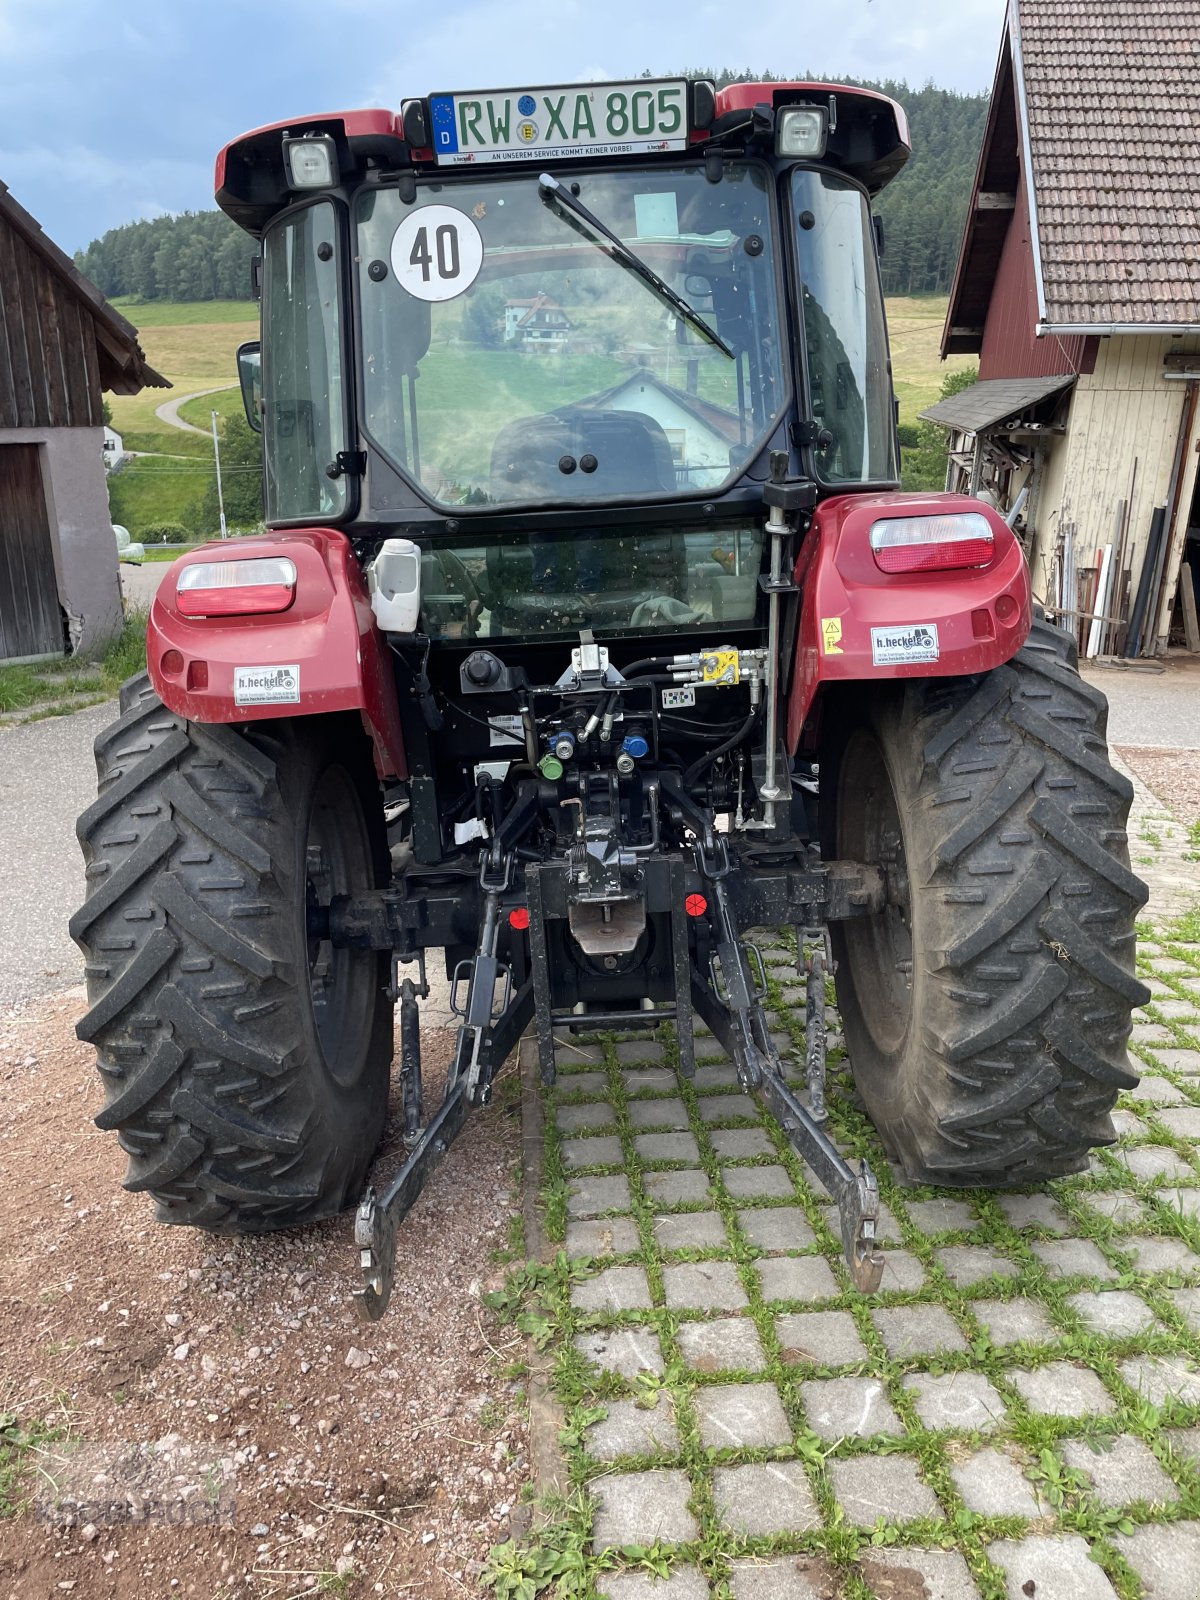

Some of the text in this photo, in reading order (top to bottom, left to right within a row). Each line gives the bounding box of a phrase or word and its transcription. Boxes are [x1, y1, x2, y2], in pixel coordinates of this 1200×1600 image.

[458, 89, 681, 146] RW XA 805
[441, 132, 450, 145] D
[503, 151, 533, 160] UNSEREM
[534, 149, 559, 158] SERVICE
[561, 148, 584, 156] KOMMT
[585, 146, 609, 155] KEINER
[609, 145, 633, 153] VORBEI
[409, 224, 460, 282] 40
[877, 636, 923, 648] h.heckele
[239, 676, 284, 688] h.heckele
